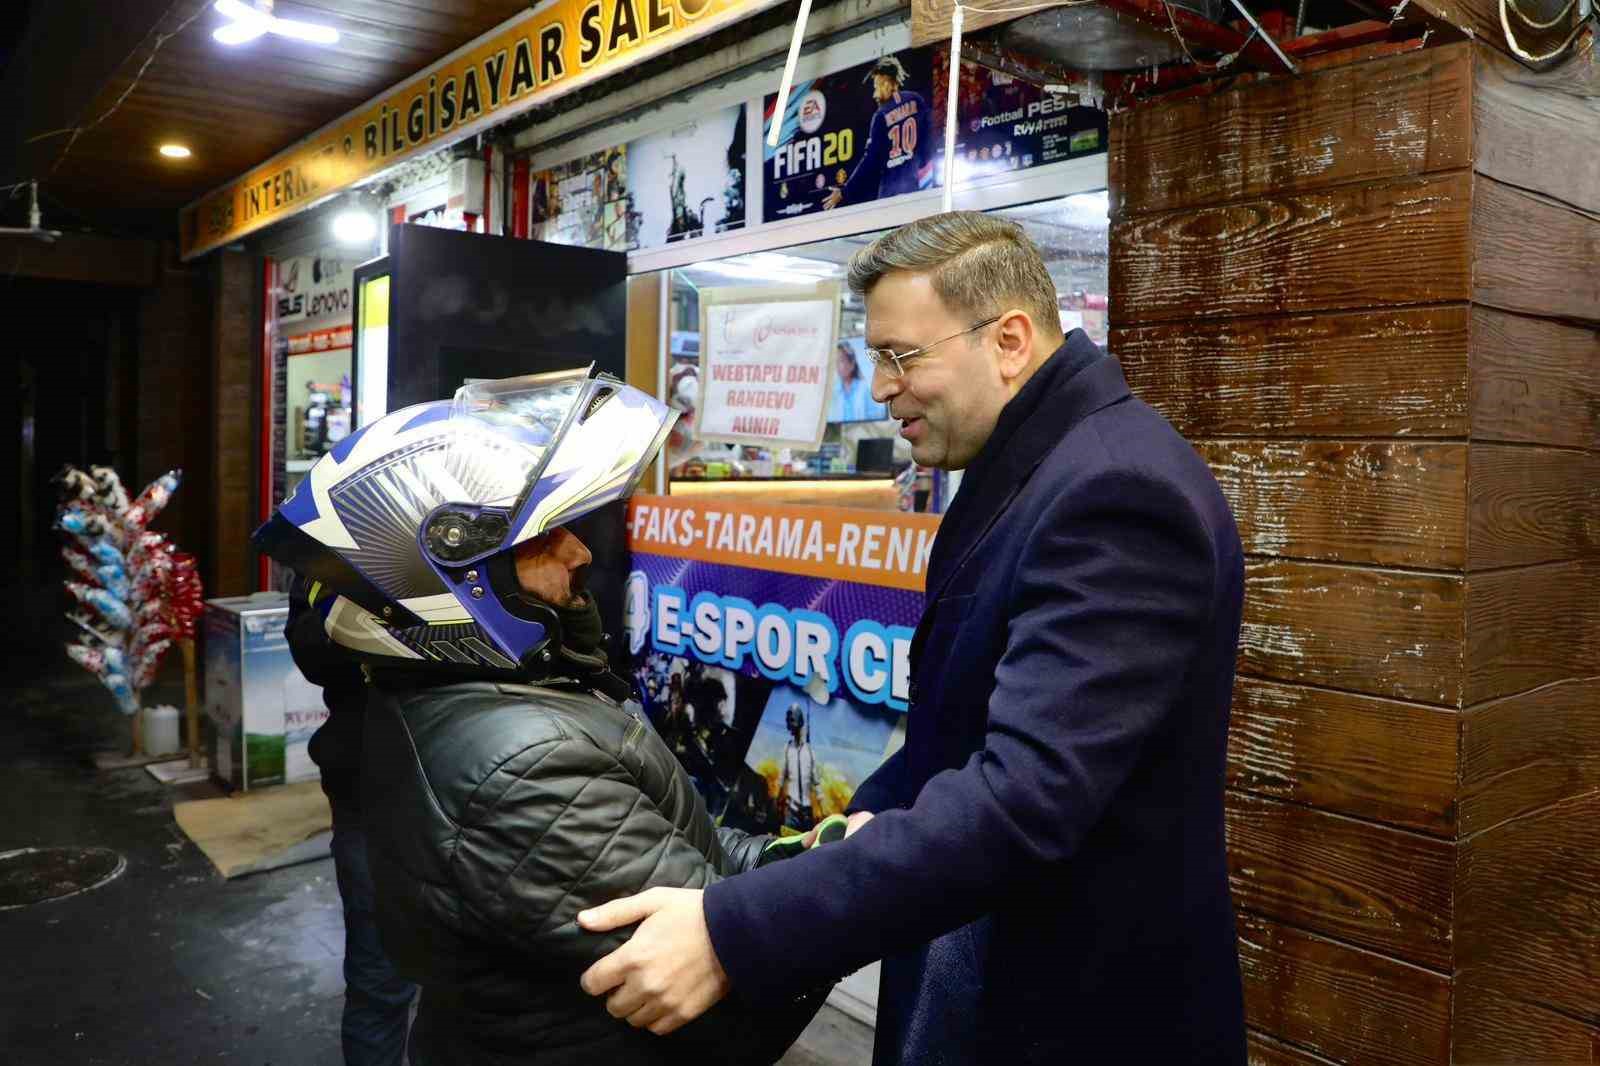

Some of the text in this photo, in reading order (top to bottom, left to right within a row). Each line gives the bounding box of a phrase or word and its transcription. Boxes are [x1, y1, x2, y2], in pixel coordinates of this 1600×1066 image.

[242, 146, 336, 221] İNTERN
[364, 26, 563, 159] BİLGİSAYAR
[888, 117, 917, 159] 10
[774, 136, 821, 179] FIFA
[823, 128, 853, 166] 20
[305, 287, 349, 317] Lenovo
[787, 365, 819, 384] DAN
[657, 593, 831, 681] E-SPOR
